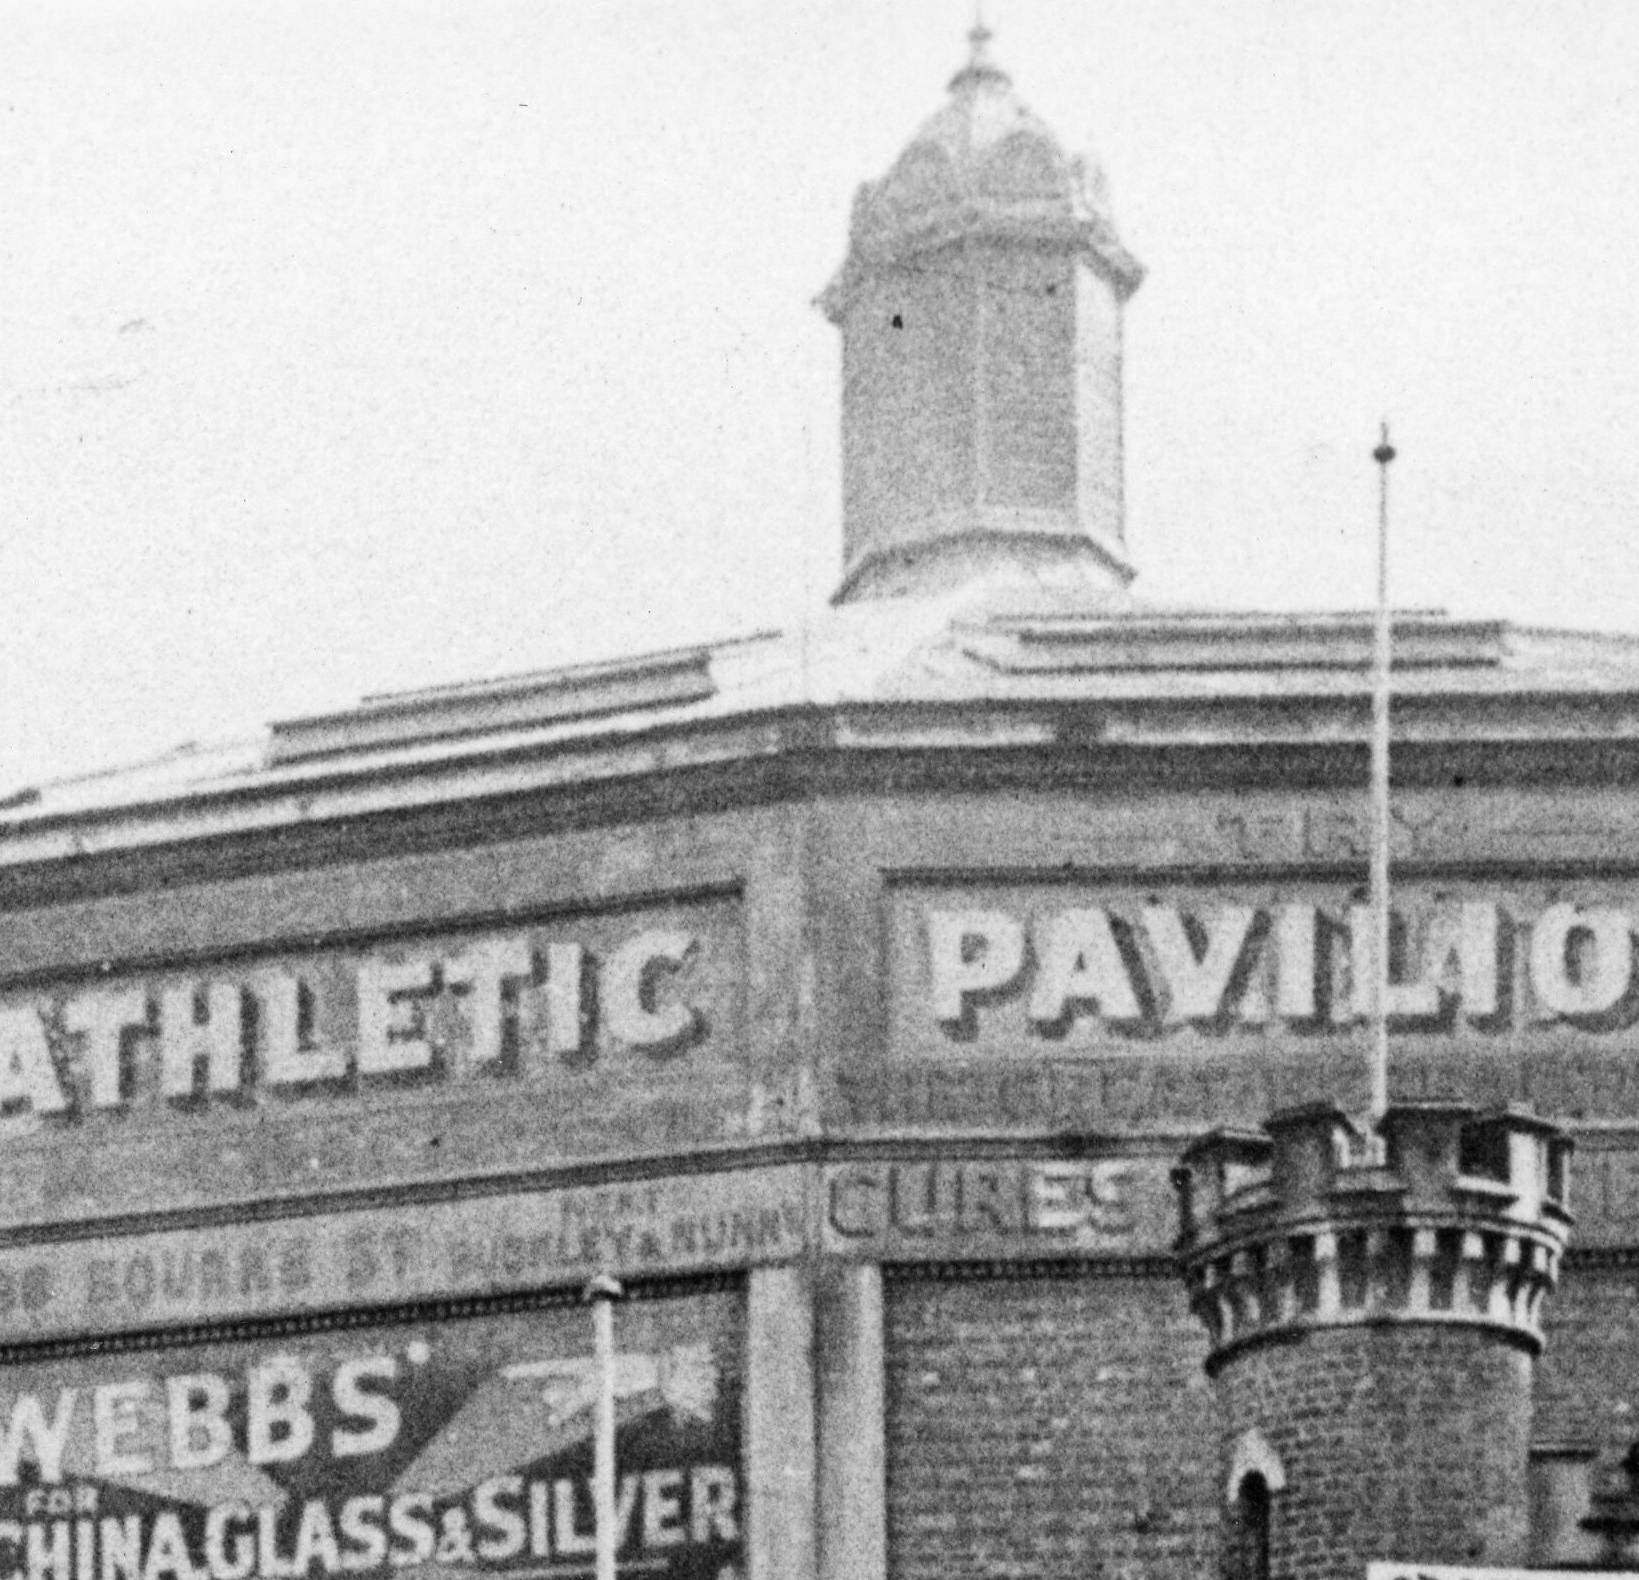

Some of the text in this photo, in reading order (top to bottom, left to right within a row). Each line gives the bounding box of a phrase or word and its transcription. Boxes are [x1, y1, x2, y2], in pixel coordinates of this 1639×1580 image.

[826, 1166, 1140, 1240] CURES
[26, 1486, 99, 1516] FOR
[434, 1505, 476, 1564] &
[471, 1464, 741, 1560] SILVER
